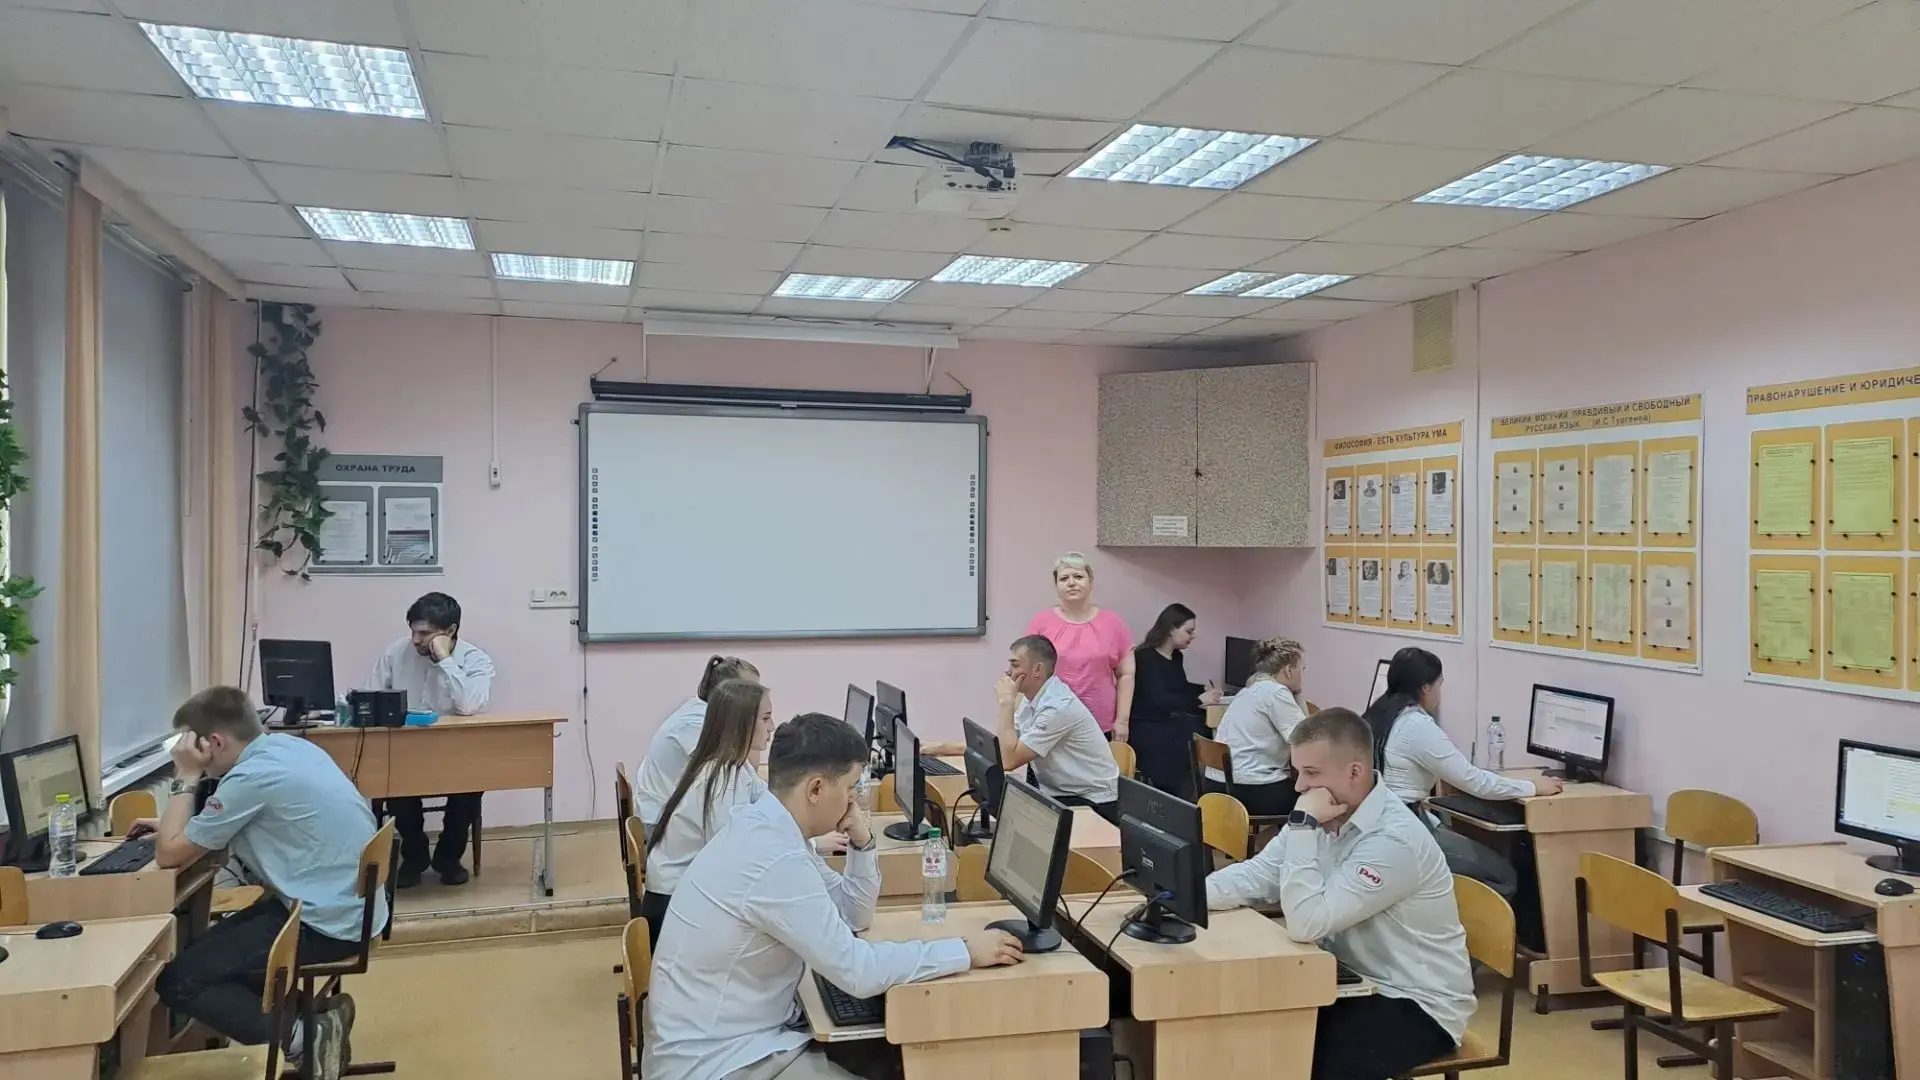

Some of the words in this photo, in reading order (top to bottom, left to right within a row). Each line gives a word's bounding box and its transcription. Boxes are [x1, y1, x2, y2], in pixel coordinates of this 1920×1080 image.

[1747, 383, 1846, 404] ПРАВОНАРУШЕНИЕ
[1849, 382, 1857, 392] И
[1624, 403, 1630, 413] И
[1632, 397, 1691, 412] СВОБОДНЫЙ
[1334, 438, 1373, 450] ФИЛОСОФИЯ
[1377, 435, 1395, 446] ЕСТЬ
[1395, 431, 1430, 444] КУЛЬТУРА
[1431, 428, 1448, 439] УМА
[335, 463, 379, 473] ОХРАНА
[381, 464, 416, 474] ТРУДА
